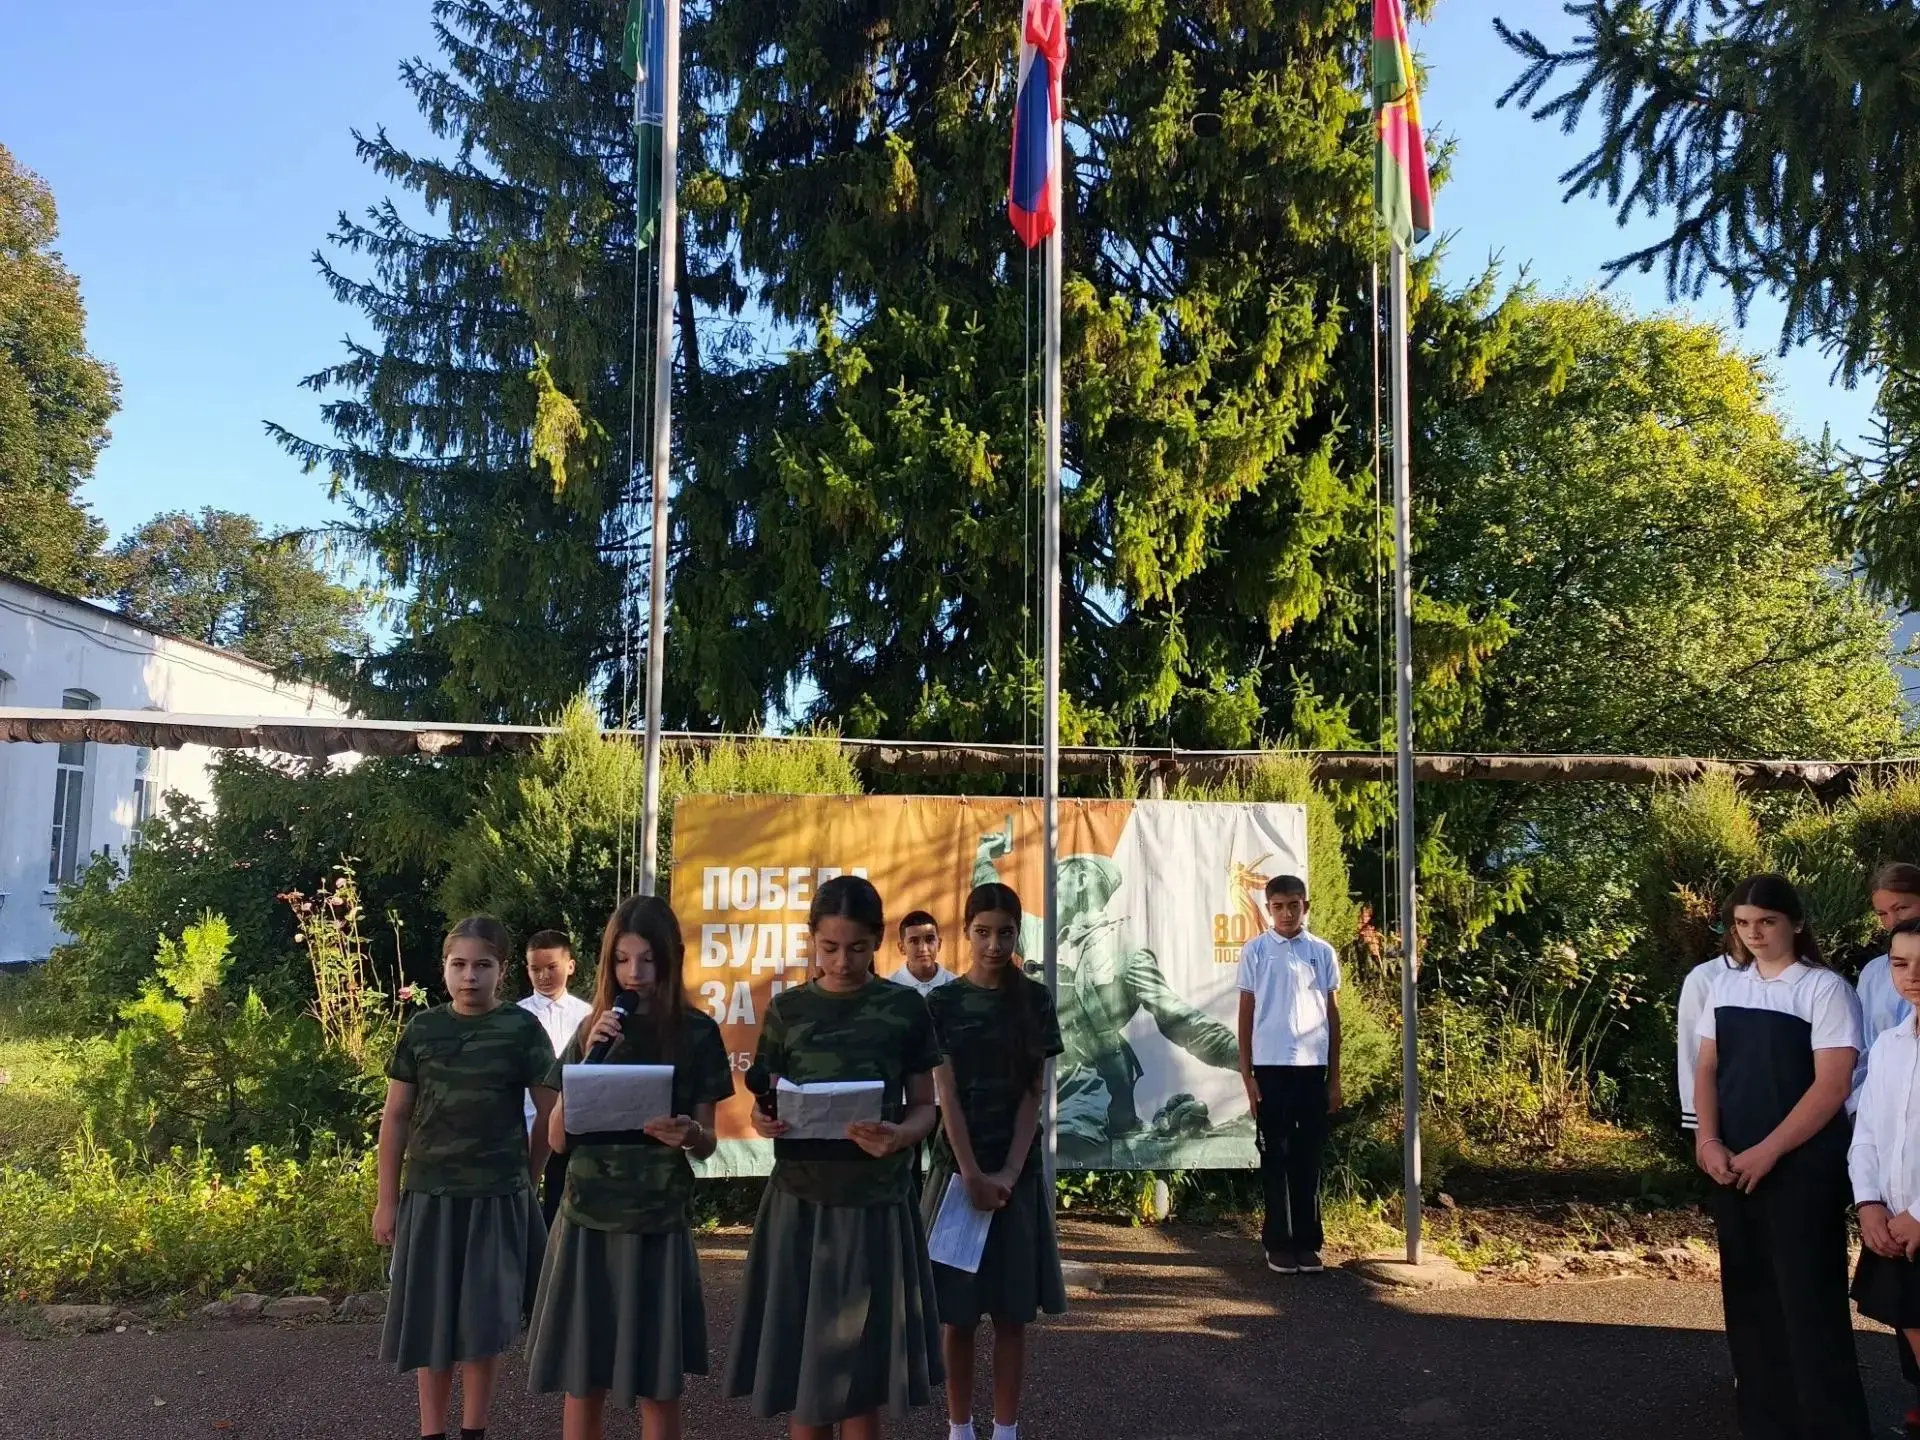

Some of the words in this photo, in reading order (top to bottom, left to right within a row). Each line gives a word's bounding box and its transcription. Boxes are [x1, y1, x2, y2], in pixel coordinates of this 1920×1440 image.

[702, 866, 868, 911] ПОБЕ
[700, 923, 820, 975] БУДЕ
[1214, 913, 1246, 943] 80
[1214, 948, 1241, 963] ПОБ
[700, 980, 756, 1025] ЗА
